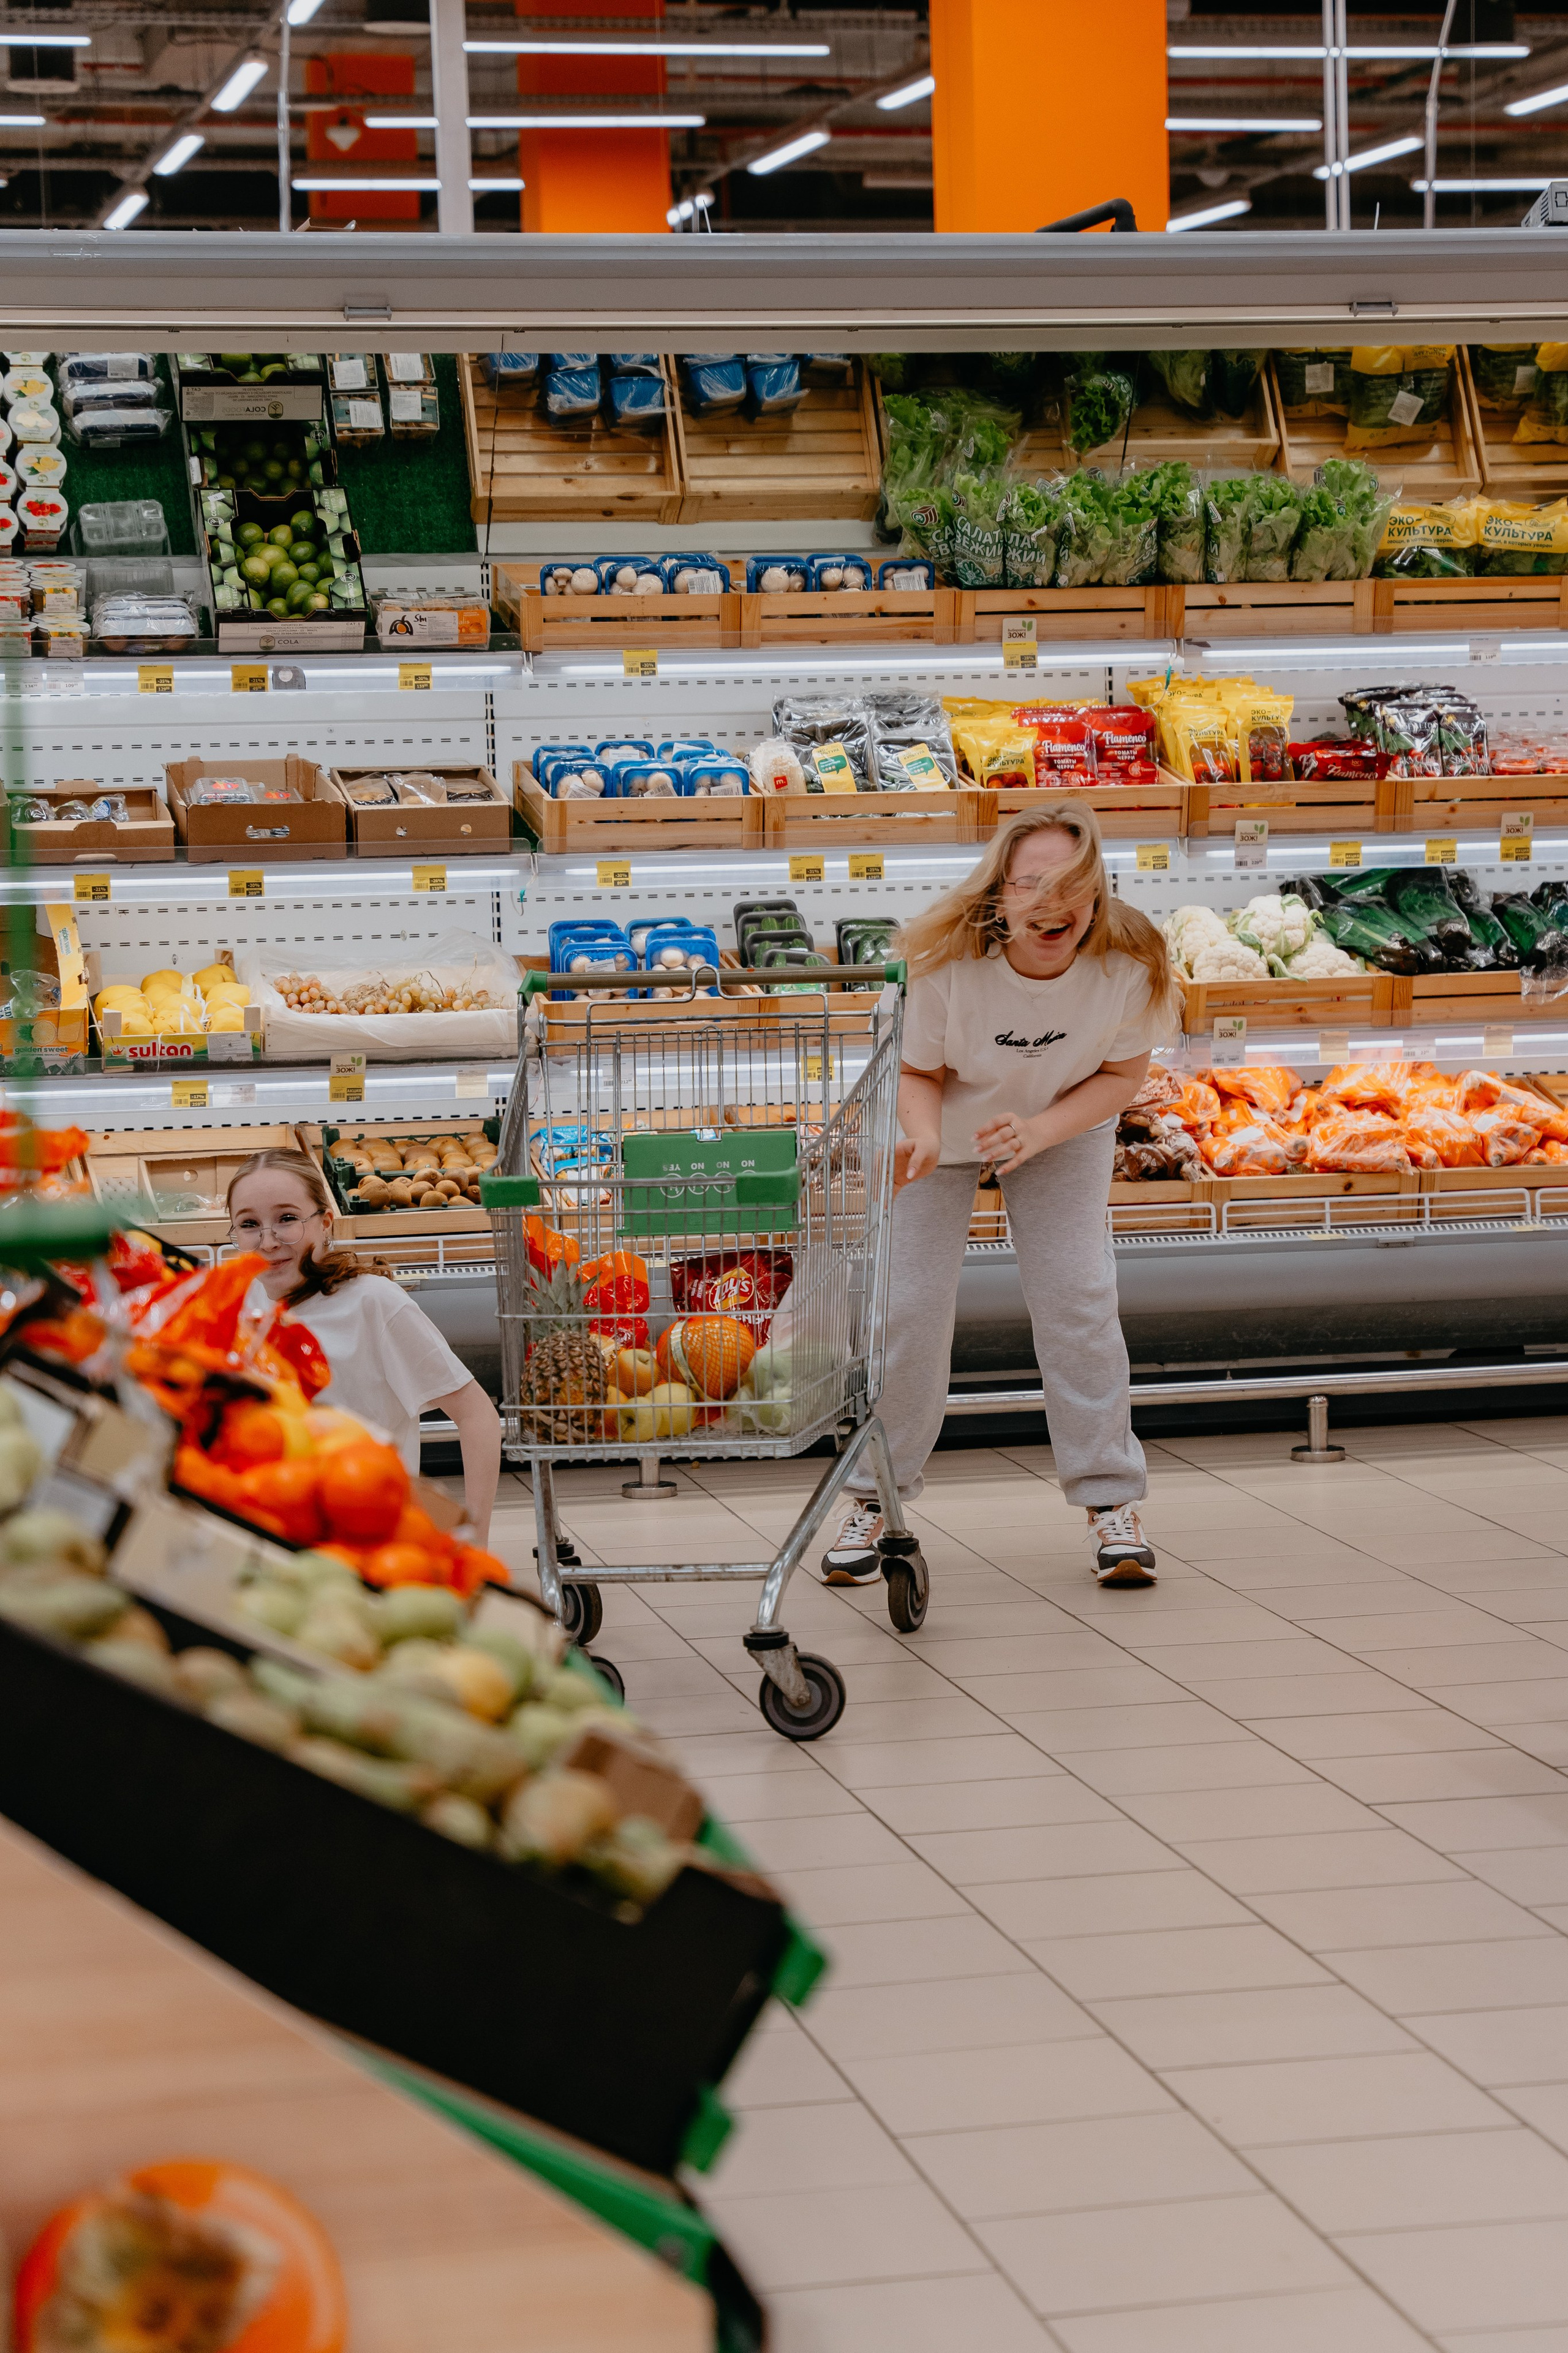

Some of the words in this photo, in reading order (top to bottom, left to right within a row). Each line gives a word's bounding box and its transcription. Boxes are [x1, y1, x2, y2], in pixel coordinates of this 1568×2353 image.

[1389, 516, 1422, 526] ЭКО-
[1487, 515, 1522, 526] ЭКО-
[957, 515, 1001, 545] САЛАТ
[1387, 525, 1452, 537] КУЛЬТУРА
[1484, 526, 1553, 542] КУЛЬТУРА
[1102, 731, 1147, 745] Flamenco
[1042, 739, 1085, 753] Flamenco
[1327, 764, 1378, 780] Flamenco
[995, 1030, 1031, 1047] Santa
[128, 1041, 192, 1057] sultan
[662, 1163, 680, 1172] YES
[712, 1277, 751, 1304] Lay's
